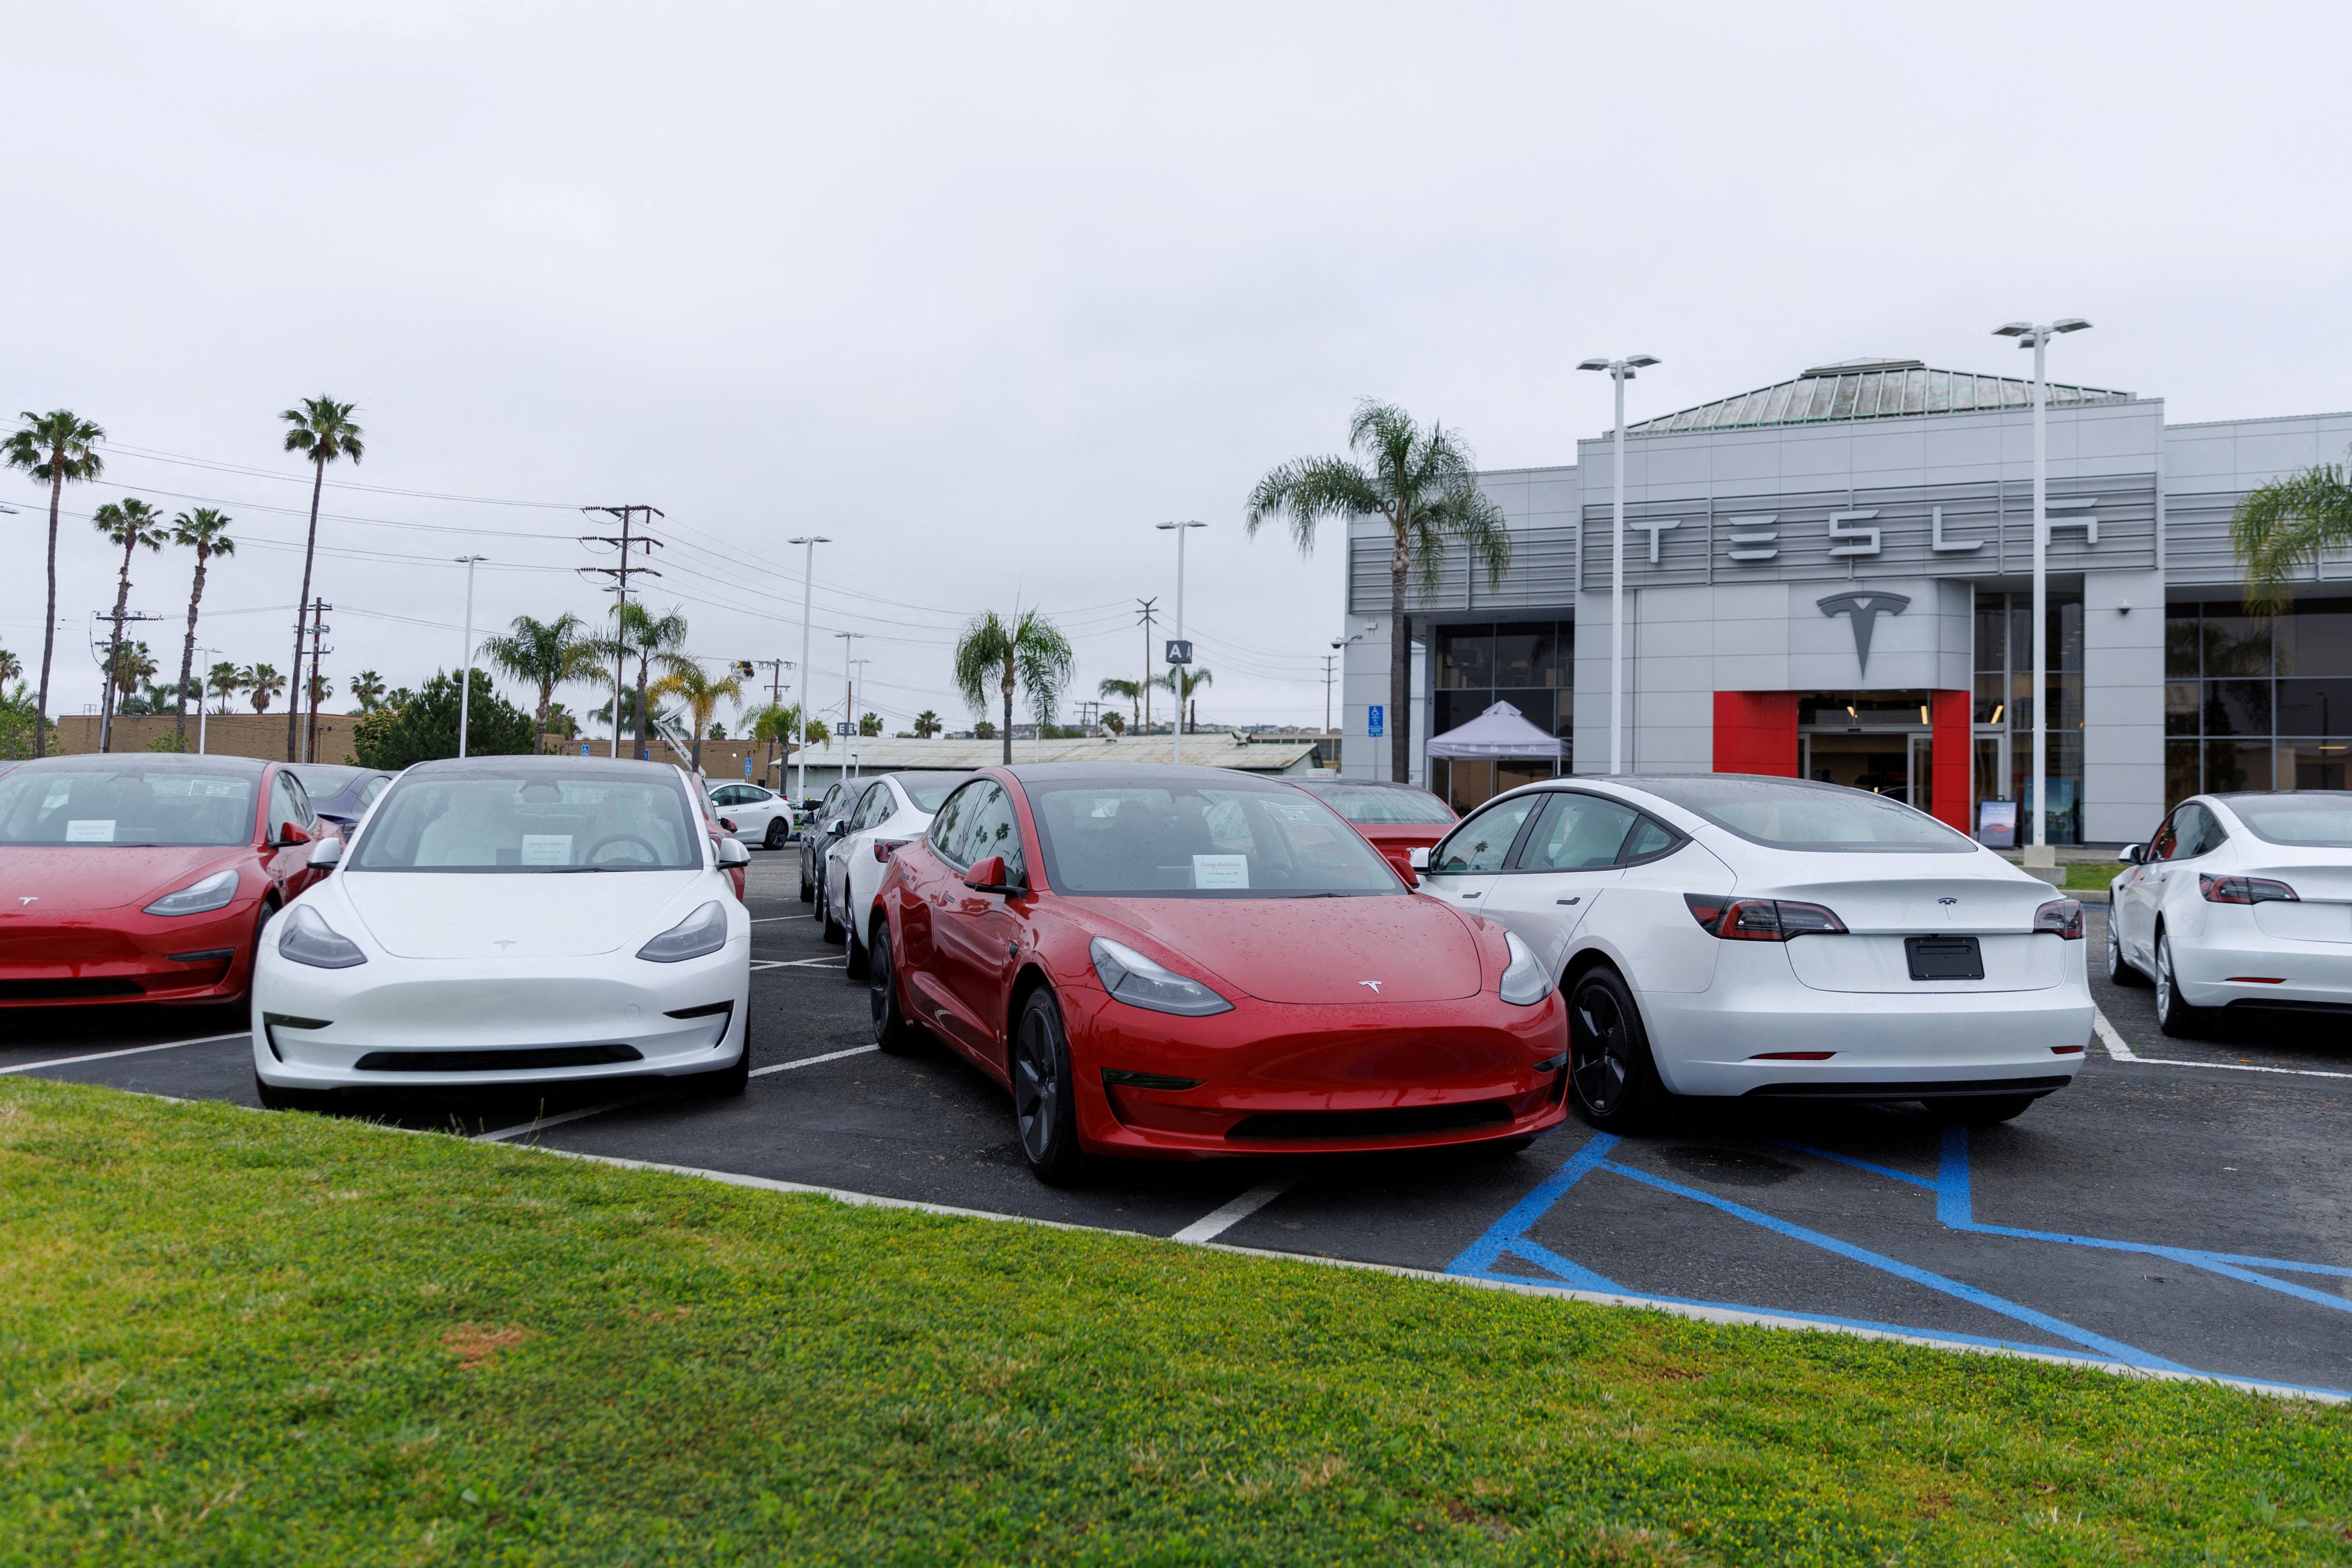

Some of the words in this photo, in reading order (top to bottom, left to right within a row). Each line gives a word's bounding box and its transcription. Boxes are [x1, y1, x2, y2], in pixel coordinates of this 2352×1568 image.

[1628, 497, 2098, 563] TESLA
[1168, 643, 1183, 658] A
[1186, 645, 1191, 659] A
[839, 724, 845, 733] E
[849, 724, 853, 733] E
[1450, 744, 1536, 752] TESLA
